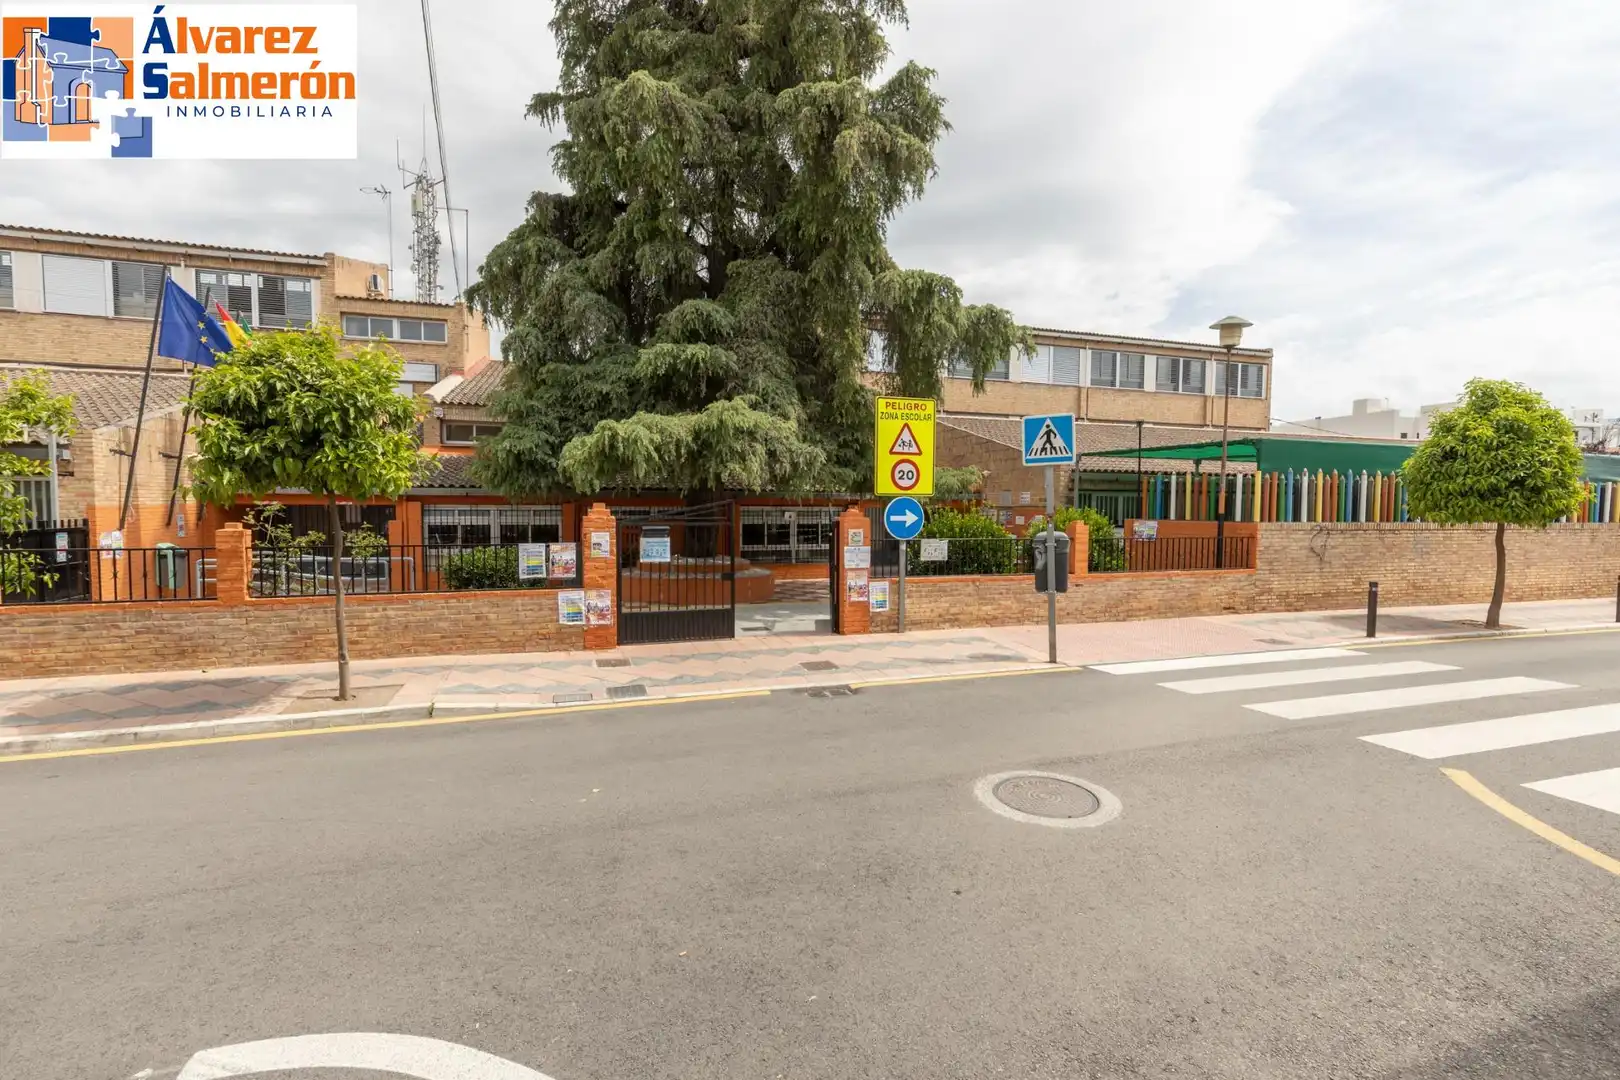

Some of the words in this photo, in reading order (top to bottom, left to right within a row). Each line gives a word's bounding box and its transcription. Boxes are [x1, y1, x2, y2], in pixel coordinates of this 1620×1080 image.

[885, 401, 927, 411] PELIGRO
[880, 411, 899, 420] ZONA
[901, 412, 932, 421] ESCOLAR
[898, 469, 914, 480] 20
